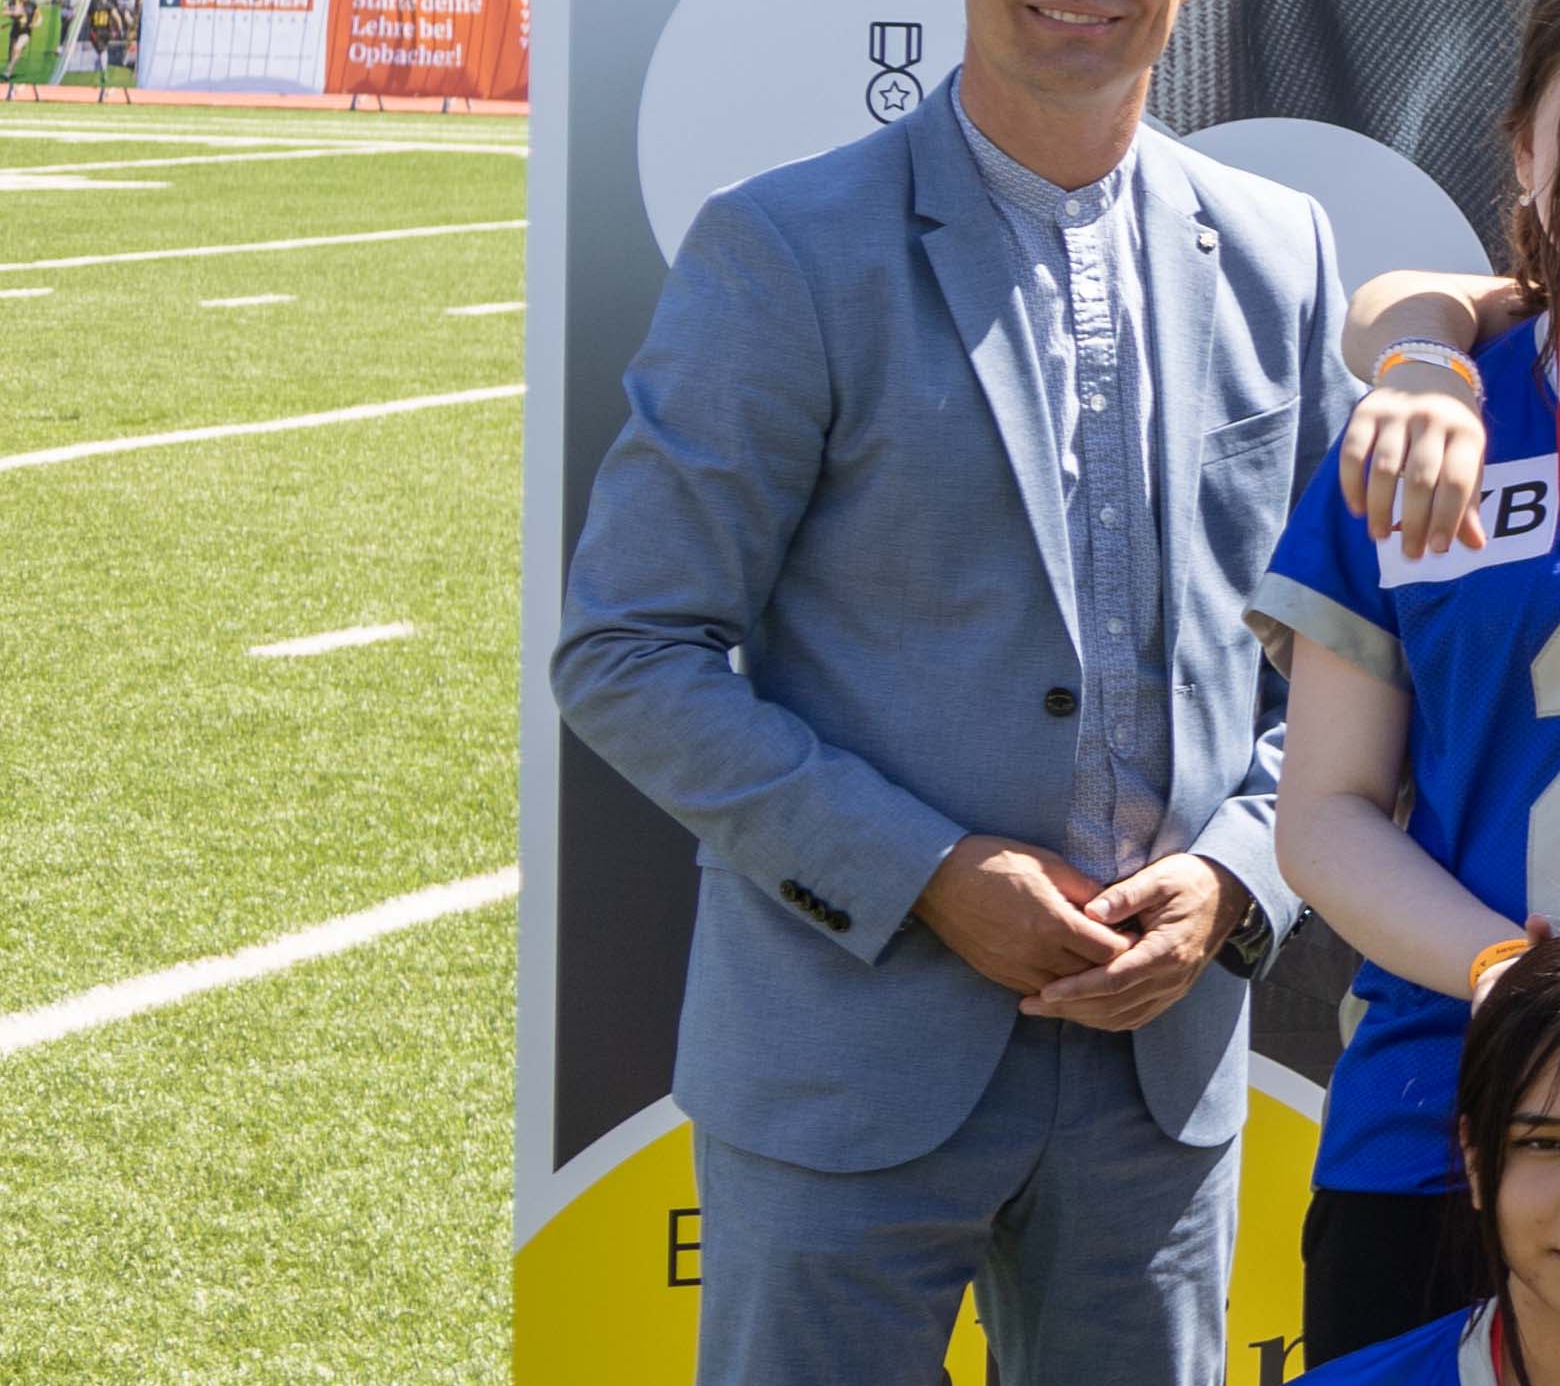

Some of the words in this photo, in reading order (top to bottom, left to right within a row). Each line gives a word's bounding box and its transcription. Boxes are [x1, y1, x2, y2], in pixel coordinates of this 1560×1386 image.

[350, 14, 415, 41] Lehre
[418, 16, 455, 42] bei
[348, 40, 464, 70] Opbacher!
